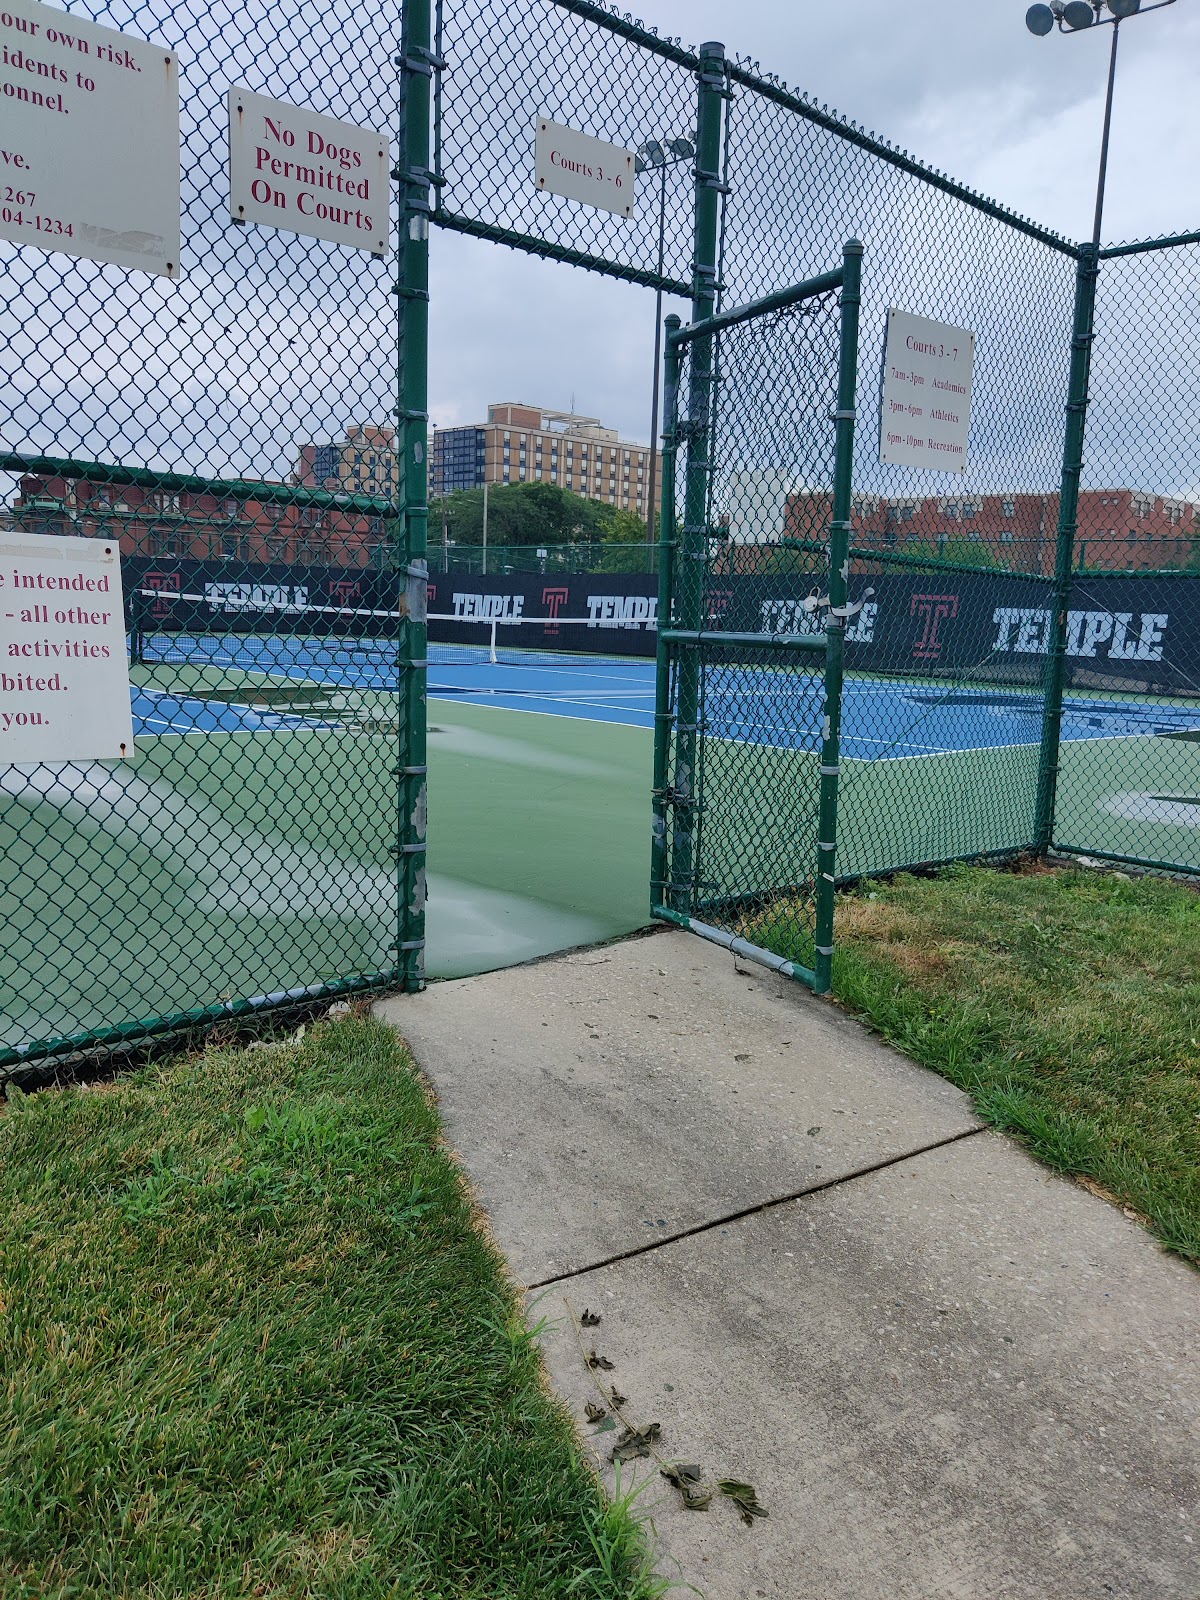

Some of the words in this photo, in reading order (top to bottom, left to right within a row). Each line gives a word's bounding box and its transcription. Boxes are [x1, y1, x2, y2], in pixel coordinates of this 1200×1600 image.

[46, 28, 90, 55] own
[96, 44, 142, 73] risk.
[0, 45, 68, 83] idents
[76, 71, 95, 92] to
[0, 81, 69, 114] onnel.
[262, 116, 295, 147] No
[306, 130, 361, 170] Dogs
[255, 146, 370, 200] Permitted
[550, 150, 593, 178] Courts
[596, 167, 603, 182] 3
[615, 174, 622, 188] 6
[0, 186, 36, 207] 267
[251, 179, 287, 209] On
[297, 192, 373, 232] Courts
[906, 335, 936, 357] Courts
[931, 377, 967, 395] Academics
[929, 408, 959, 424] Athletics
[927, 438, 963, 454] Recreation
[13, 569, 110, 593] intended
[20, 605, 49, 624] all
[54, 606, 112, 625] other
[204, 582, 309, 615] TEMPLE
[452, 593, 525, 625] TEMPLE
[587, 595, 676, 632] TEMPL
[760, 600, 878, 643] TEME
[992, 607, 1169, 662] TEMPLE
[8, 639, 110, 658] activities
[1, 712, 50, 732] you.
